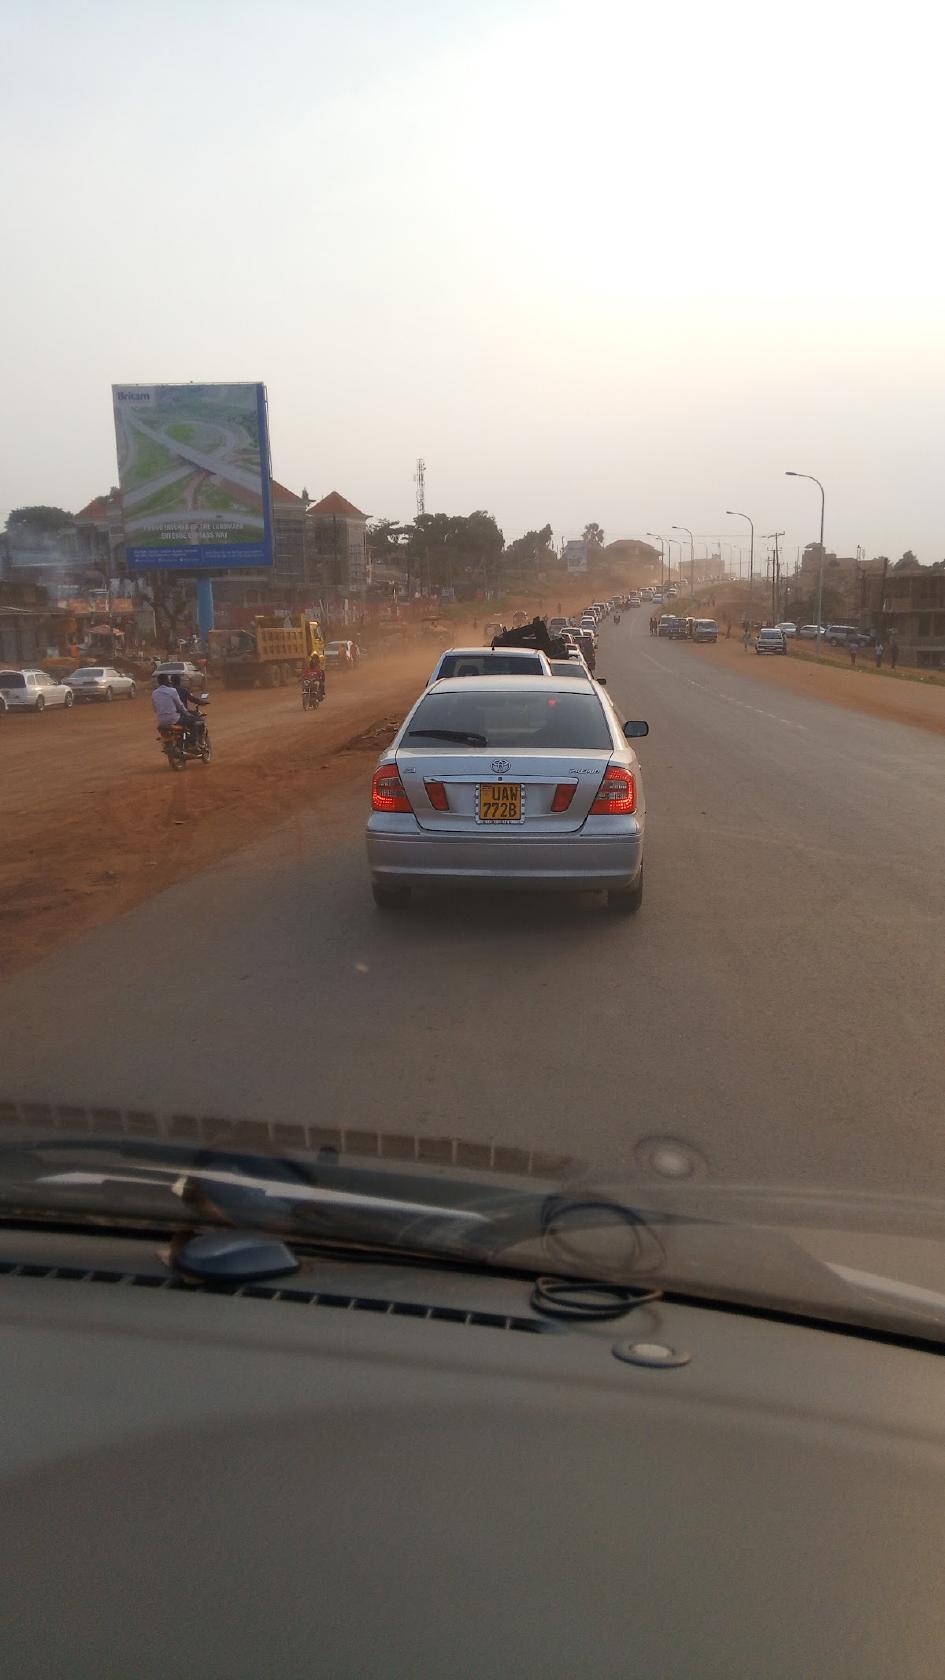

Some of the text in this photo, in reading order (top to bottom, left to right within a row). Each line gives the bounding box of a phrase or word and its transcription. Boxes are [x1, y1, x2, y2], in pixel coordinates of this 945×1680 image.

[117, 391, 150, 401] Britam
[492, 786, 518, 801] UAW
[483, 802, 517, 818] 772B
